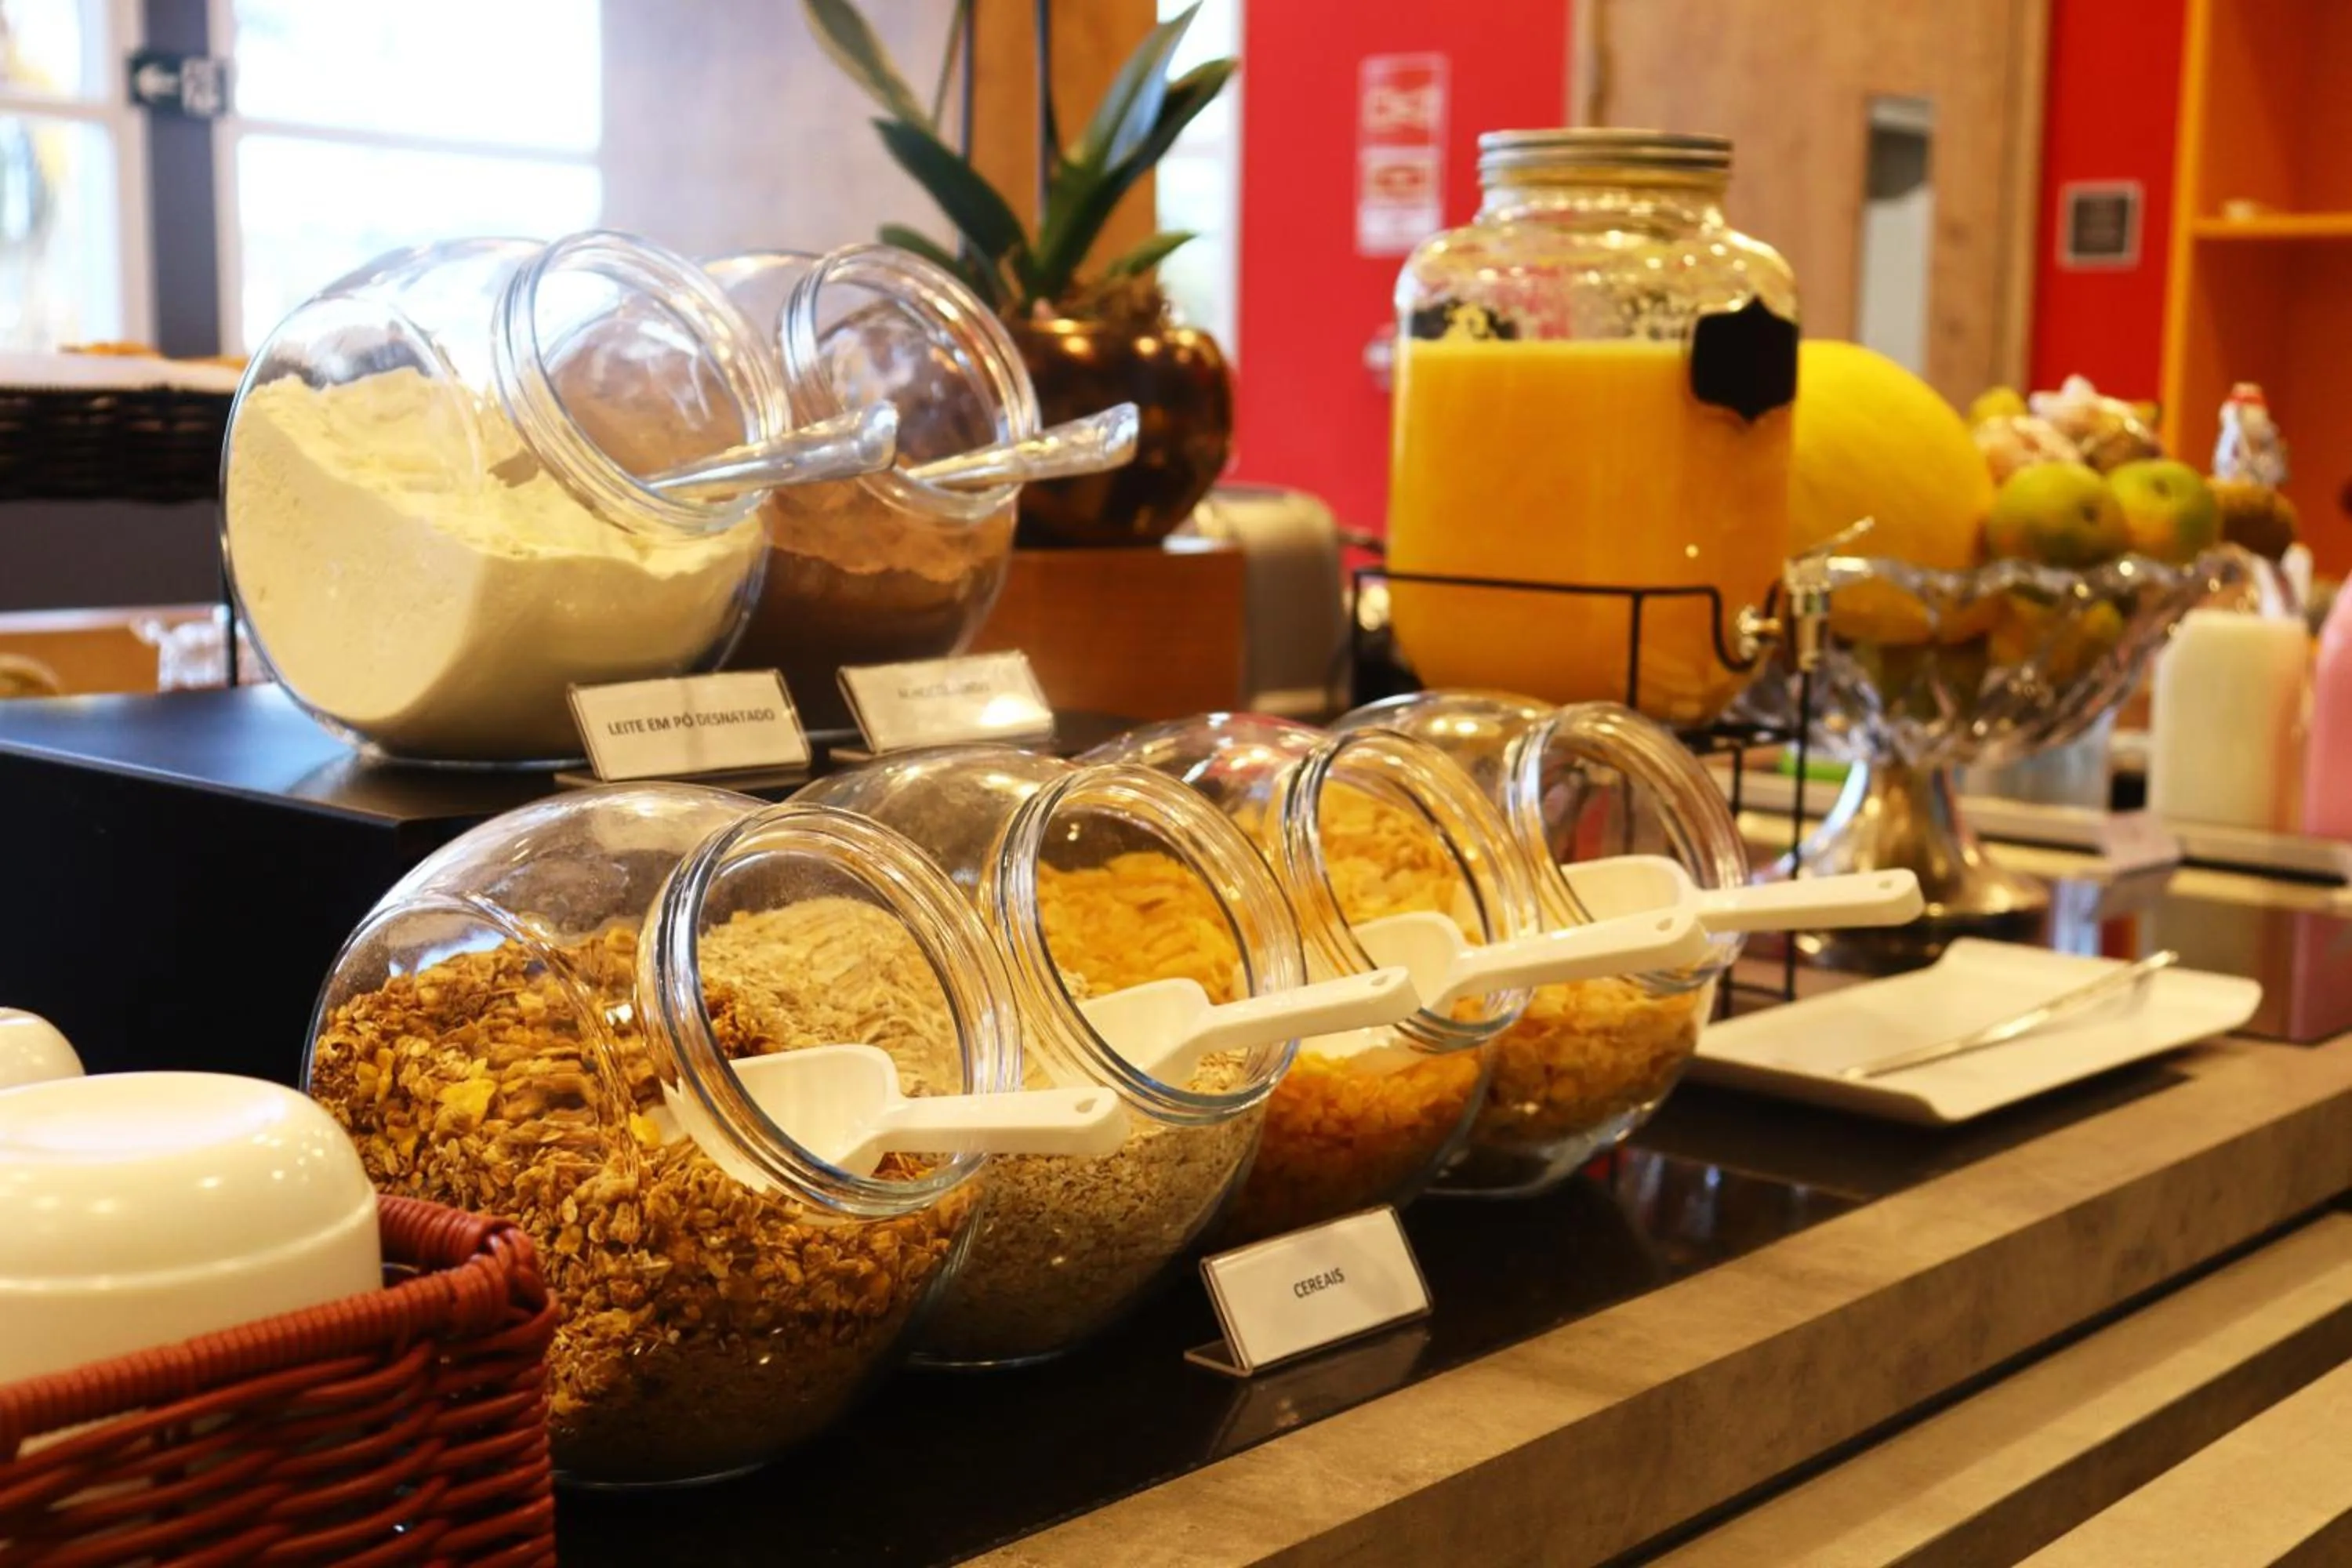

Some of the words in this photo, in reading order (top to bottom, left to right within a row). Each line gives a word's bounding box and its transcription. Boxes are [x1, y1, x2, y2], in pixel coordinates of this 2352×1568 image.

[608, 717, 645, 735] LEITE
[648, 716, 671, 731] EM
[674, 710, 695, 729] PÓ
[696, 707, 775, 726] DESNATADO
[1294, 1267, 1345, 1299] CEREAIS
